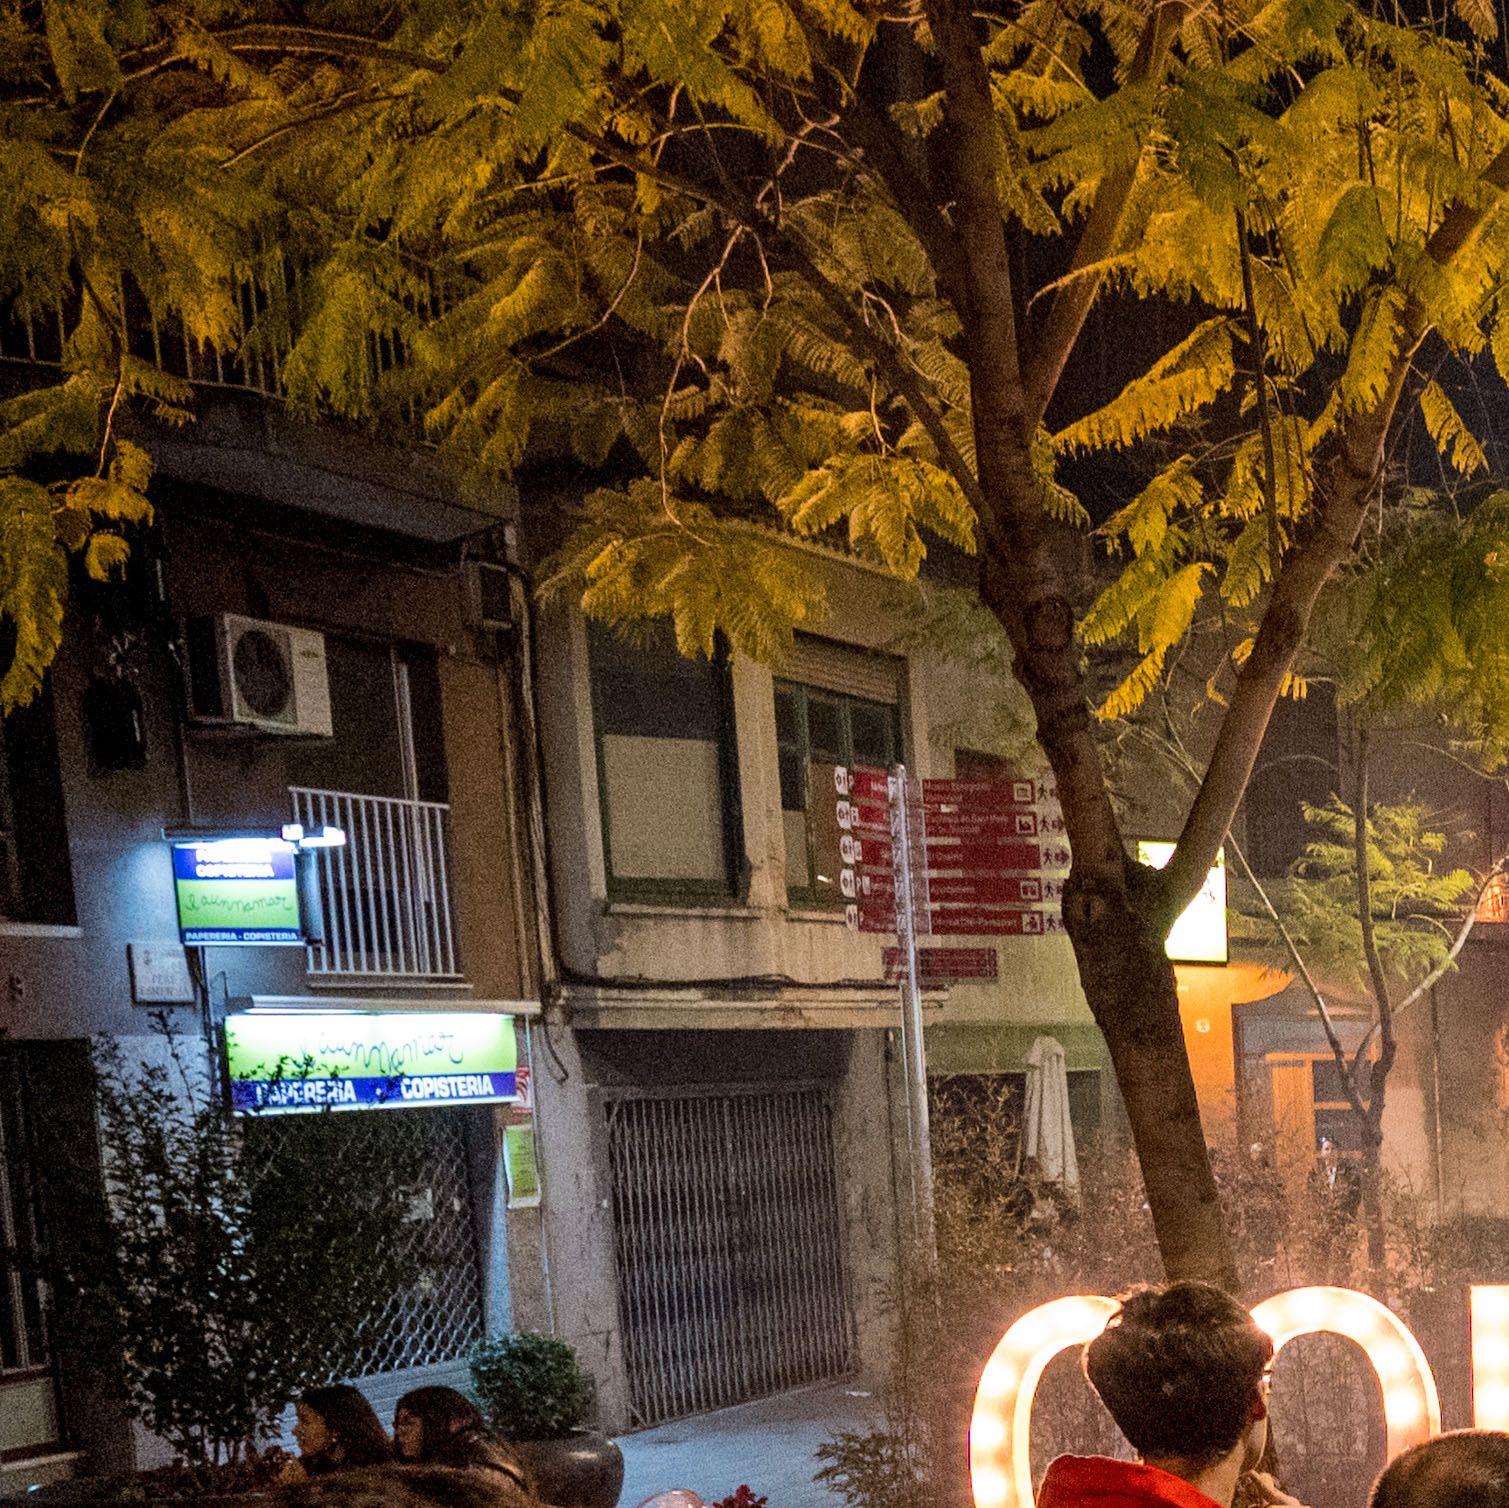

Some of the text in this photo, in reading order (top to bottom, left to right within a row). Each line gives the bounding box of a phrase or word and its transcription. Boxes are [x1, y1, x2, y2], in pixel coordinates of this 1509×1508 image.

[185, 931, 298, 941] PAPERERIA COPISTERIA
[401, 1075, 495, 1100] COPISTERIA
